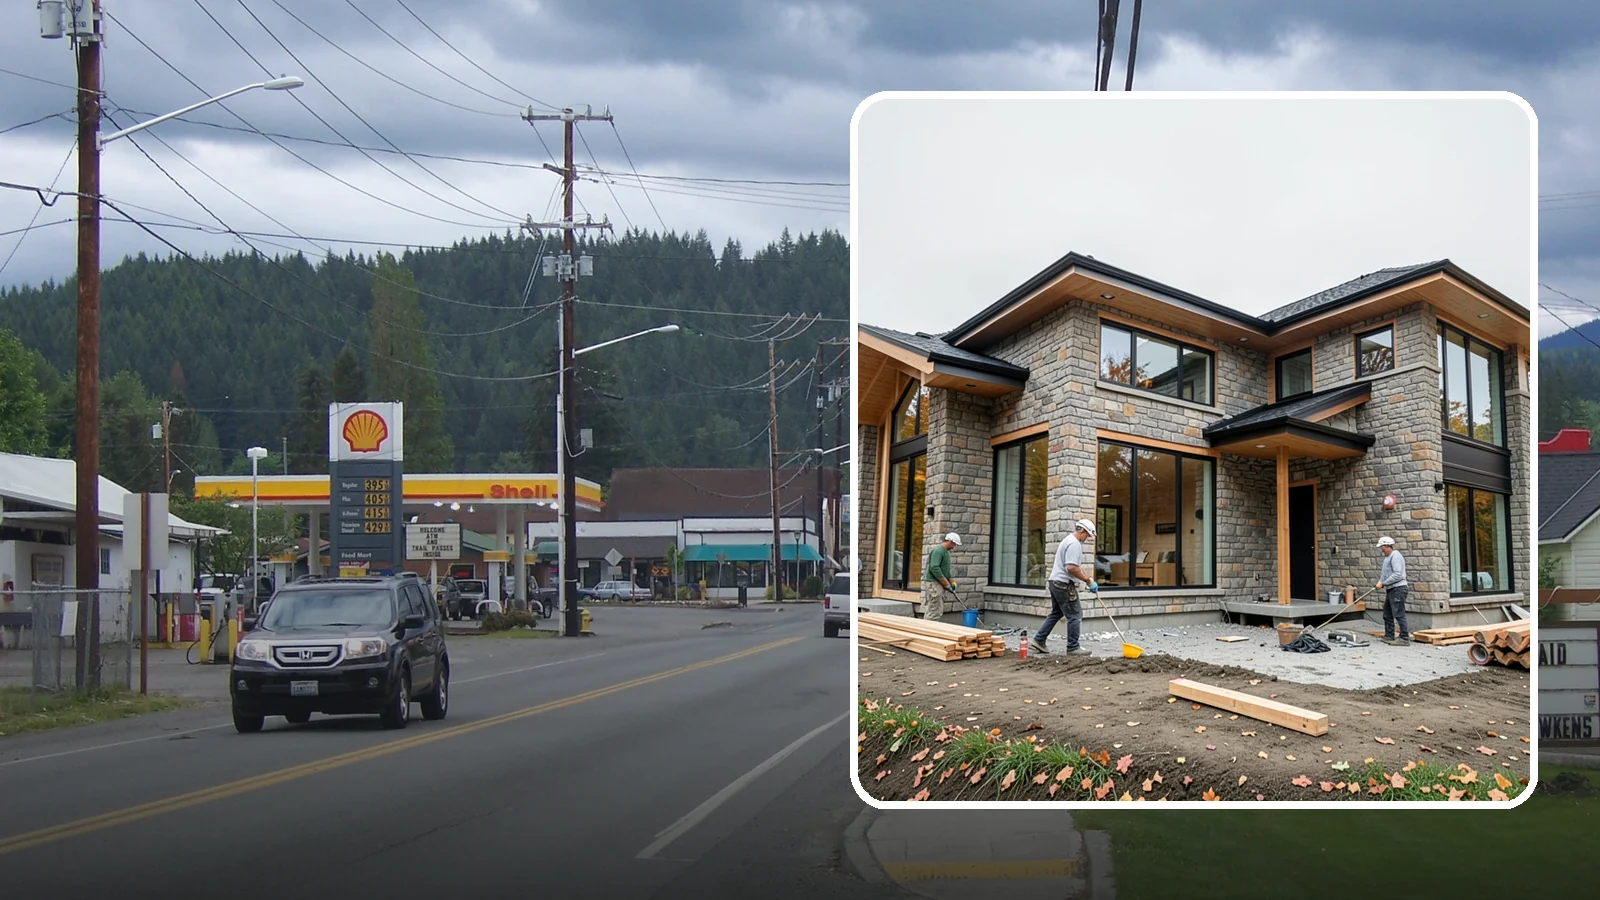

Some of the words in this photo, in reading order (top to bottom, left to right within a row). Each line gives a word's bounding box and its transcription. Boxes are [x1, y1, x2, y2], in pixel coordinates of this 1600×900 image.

[366, 480, 383, 490] 395
[490, 484, 547, 499] Shell
[366, 494, 383, 504] 405
[366, 508, 383, 518] 415
[366, 522, 383, 532] 429
